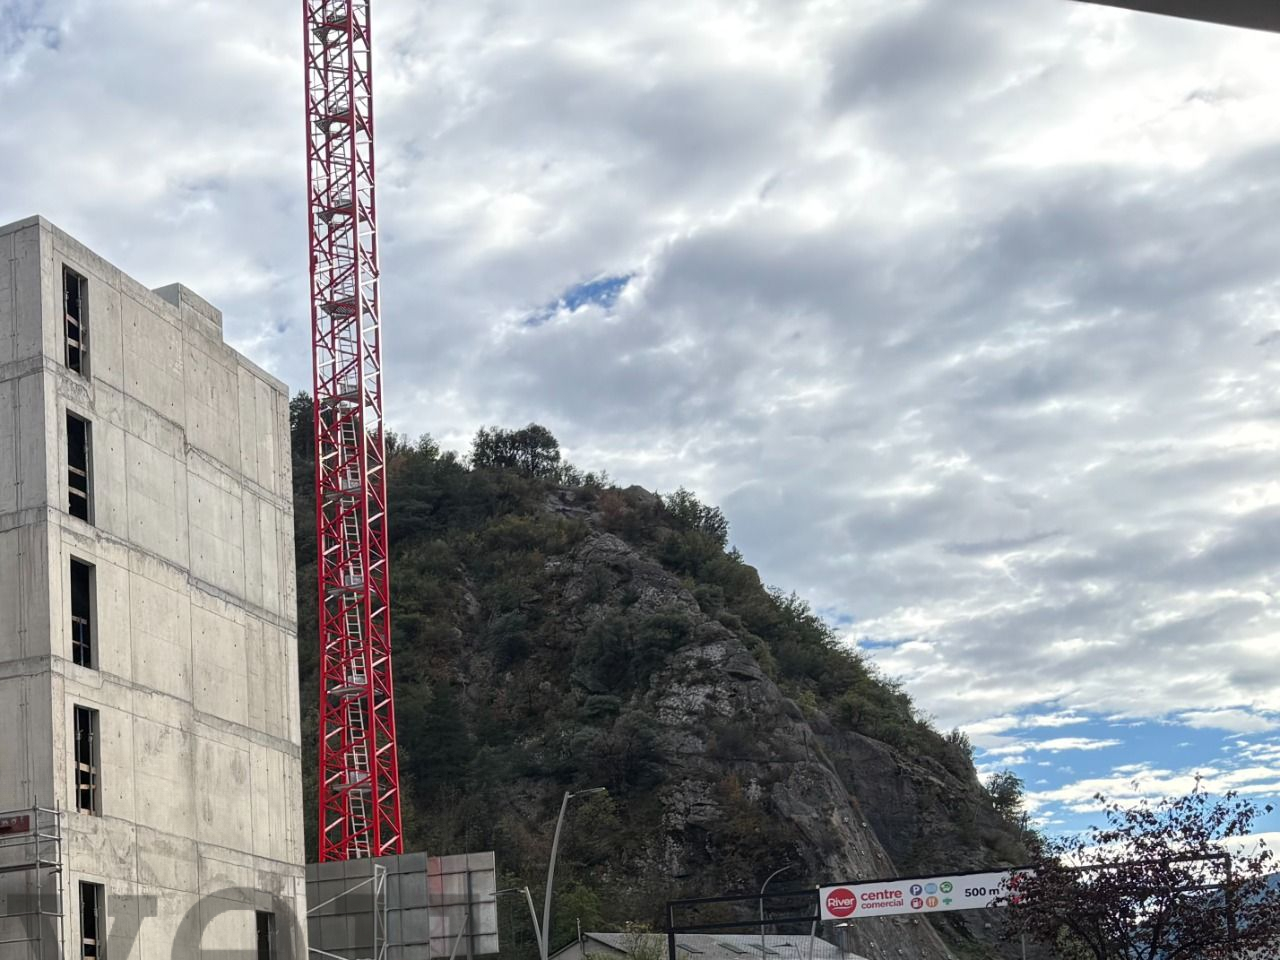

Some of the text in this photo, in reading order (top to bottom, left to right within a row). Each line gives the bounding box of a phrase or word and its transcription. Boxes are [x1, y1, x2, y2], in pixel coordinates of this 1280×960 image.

[861, 889, 903, 901] centre
[964, 888, 987, 897] 500
[827, 897, 855, 907] River
[861, 899, 904, 909] comercial
